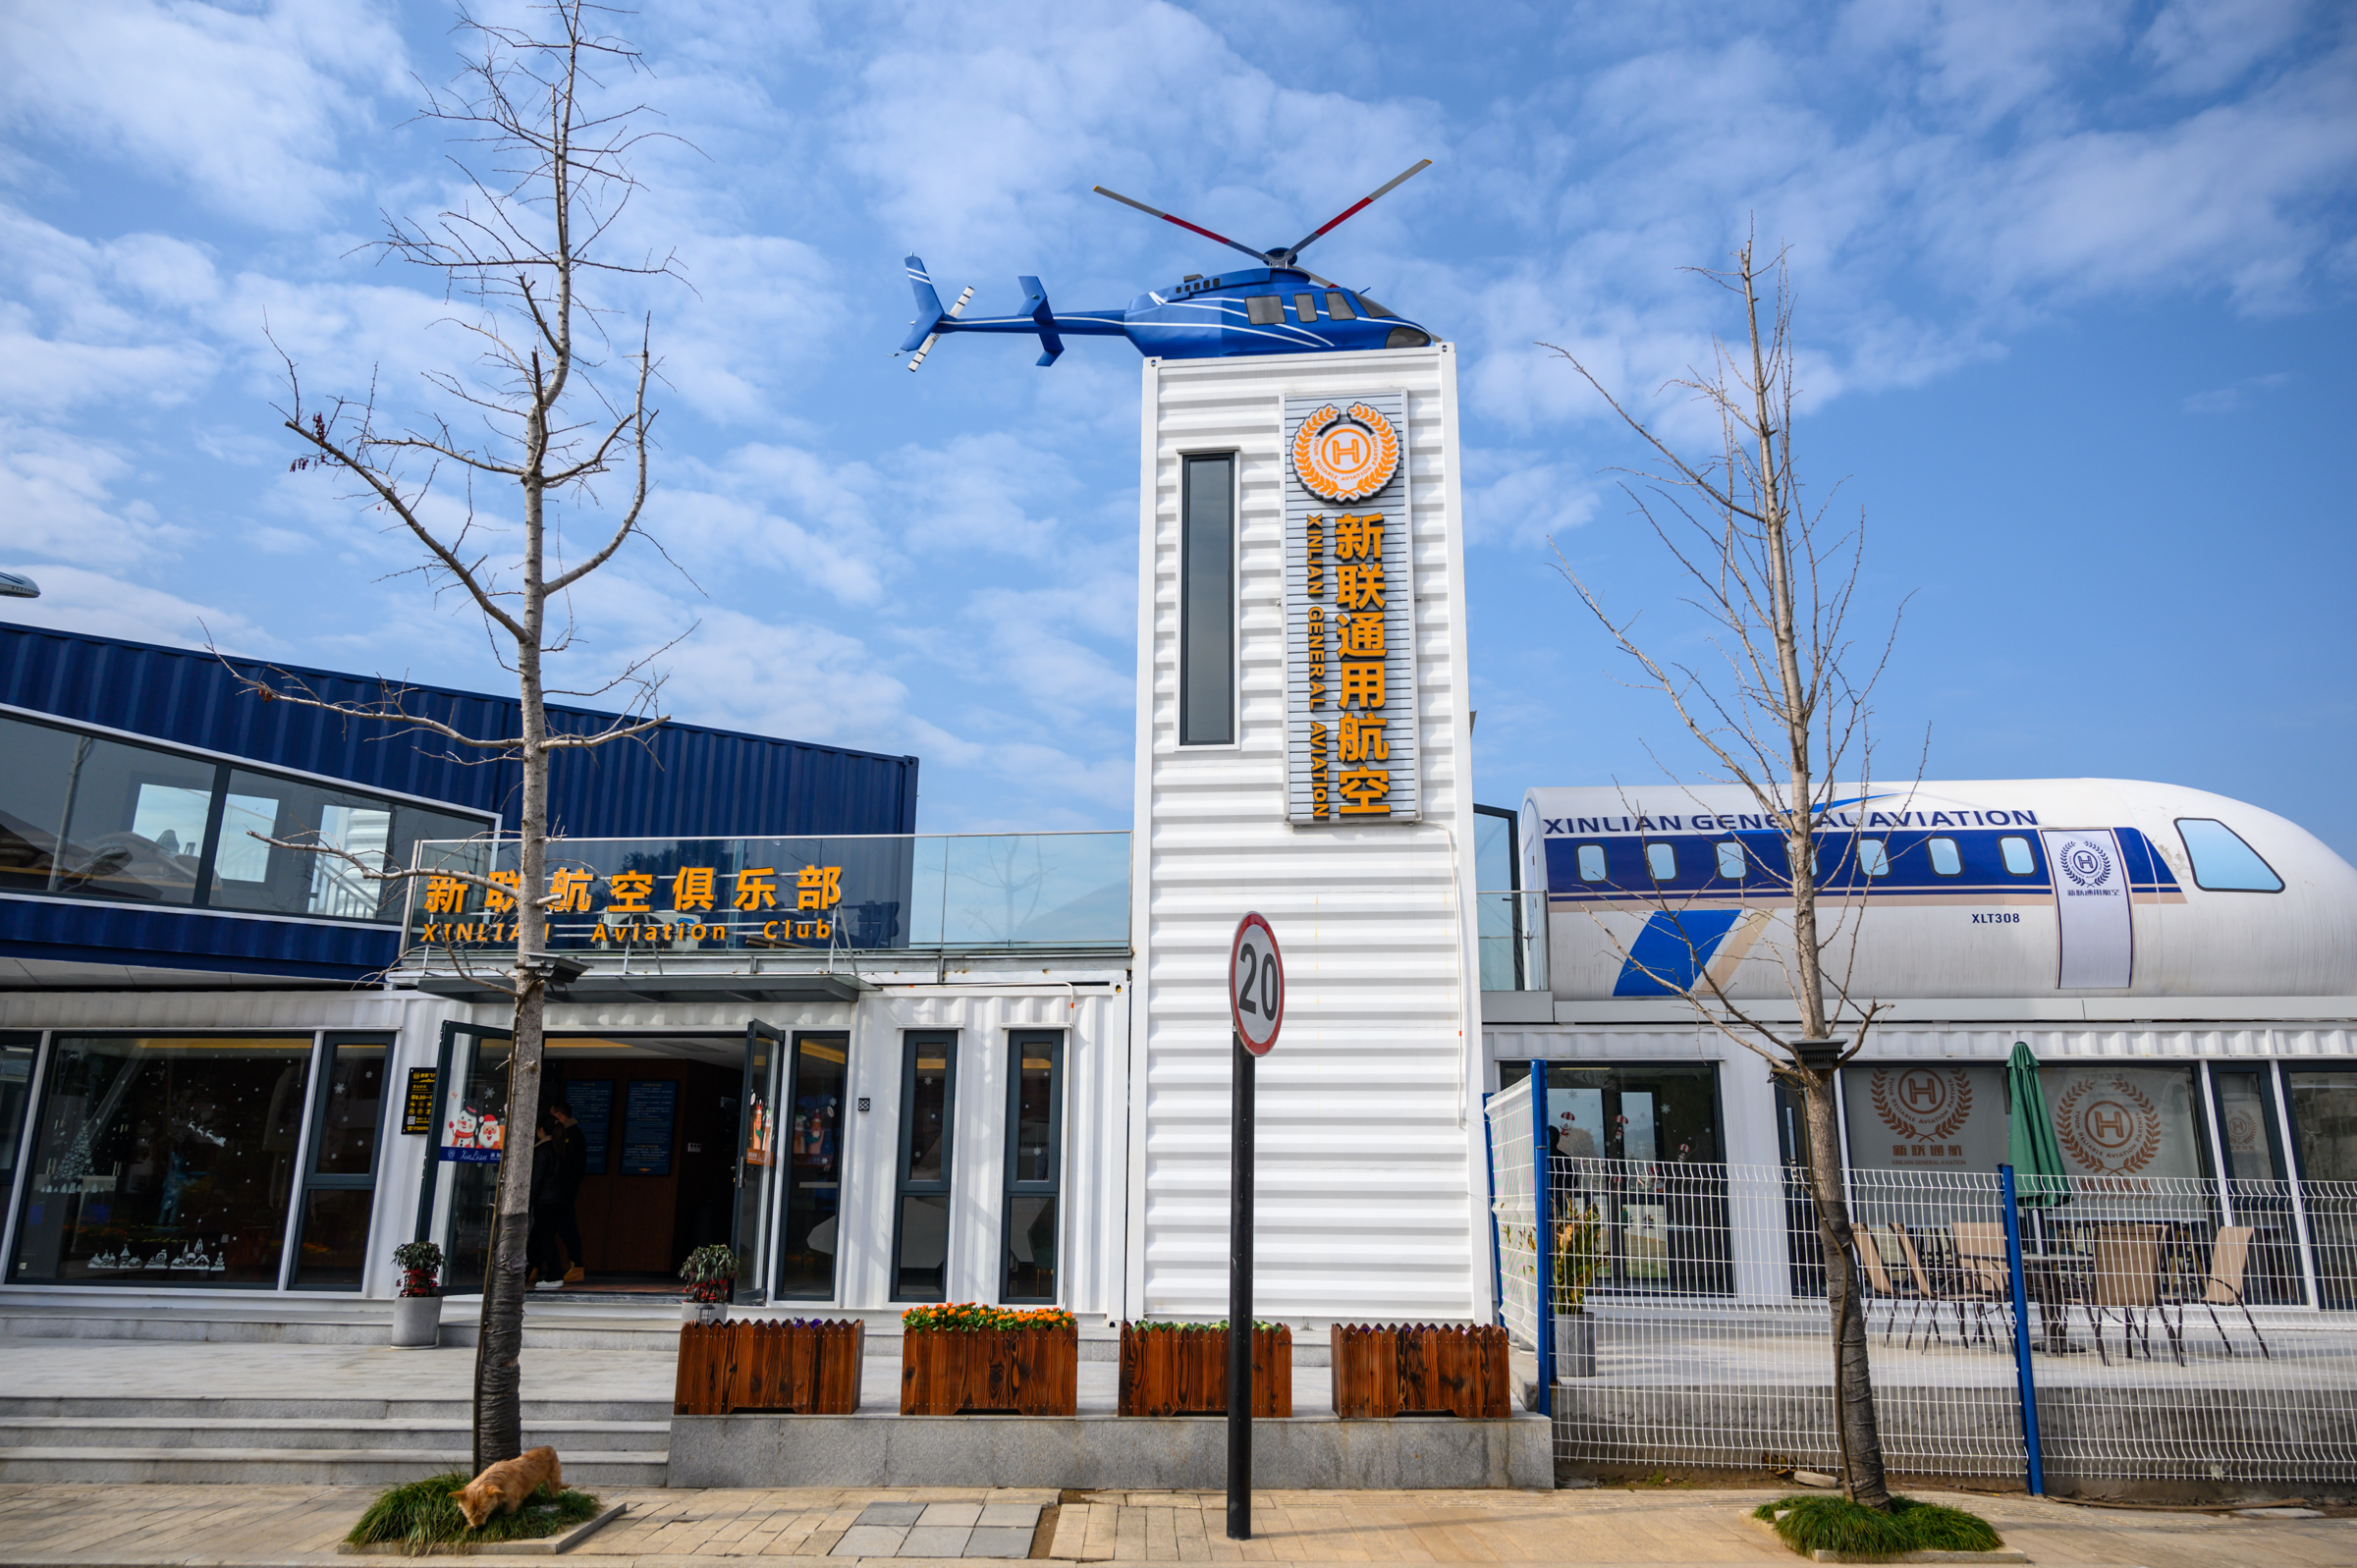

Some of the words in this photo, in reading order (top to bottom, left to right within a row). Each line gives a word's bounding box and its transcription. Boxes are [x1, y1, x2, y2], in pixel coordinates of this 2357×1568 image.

[1315, 459, 1338, 480] RELIABLE
[1341, 465, 1372, 481] AVIATION
[1307, 514, 1324, 596] XINLIAN
[1308, 607, 1326, 710] GENERAL
[1335, 513, 1391, 815] 新联通用航空
[1310, 722, 1329, 818] AVIATION
[1543, 815, 1682, 834] XINLIAN
[1691, 813, 1860, 831] GENEAL
[1869, 810, 2039, 828] AVIATION
[423, 865, 843, 914] 新联航空俱乐部
[419, 923, 551, 943] XINLIA
[590, 922, 727, 942] Aviation
[763, 918, 832, 941] Club
[1971, 913, 2020, 923] XLT308
[1238, 943, 1279, 1021] 20
[1891, 1099, 1916, 1122] RELIABLE
[1918, 1109, 1949, 1124] AVIATION
[1946, 1078, 1955, 1108] PARTNER
[1892, 1144, 1962, 1157] 新联通航
[2078, 1132, 2104, 1157] RELIABLE
[2106, 1144, 2137, 1158] AVIATION
